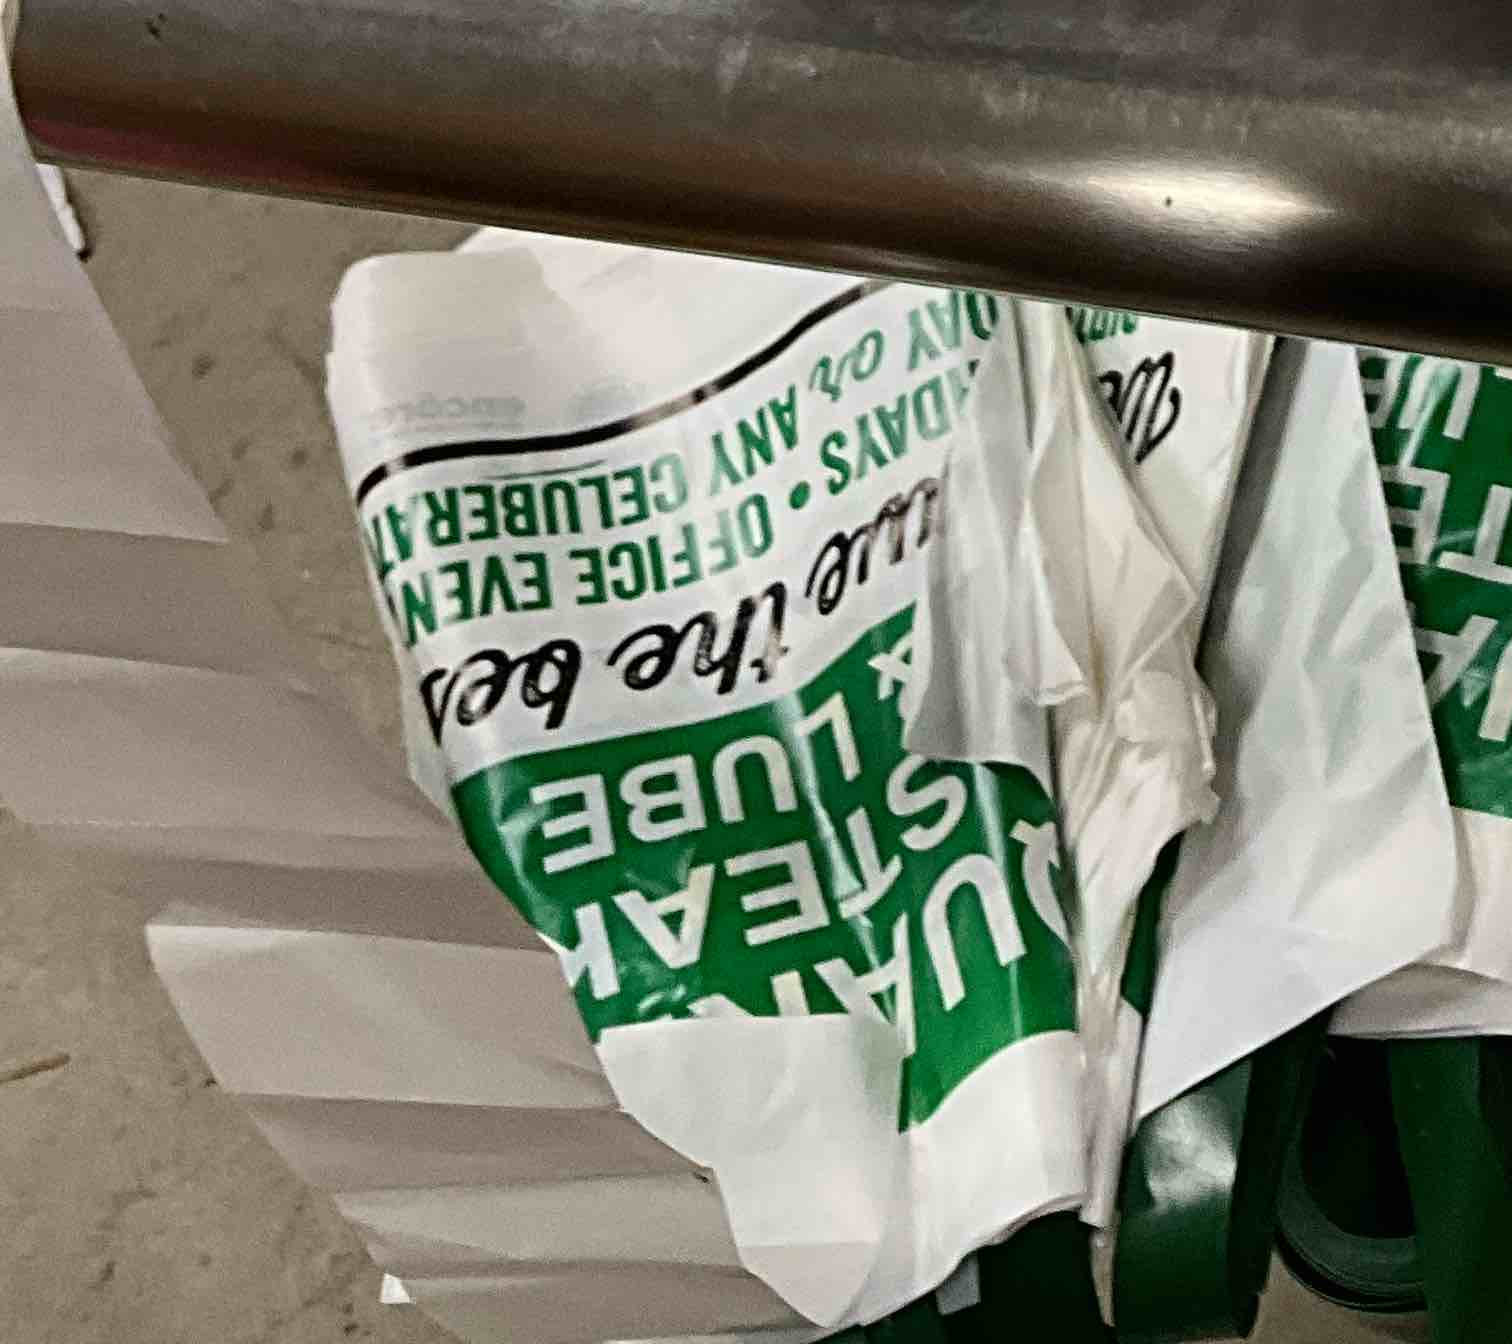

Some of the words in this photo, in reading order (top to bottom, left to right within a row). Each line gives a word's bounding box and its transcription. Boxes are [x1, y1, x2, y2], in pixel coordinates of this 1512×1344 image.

[709, 384, 799, 497] ANY
[567, 492, 775, 607] OFFICE
[606, 581, 788, 696] the
[529, 692, 862, 877] LUBE
